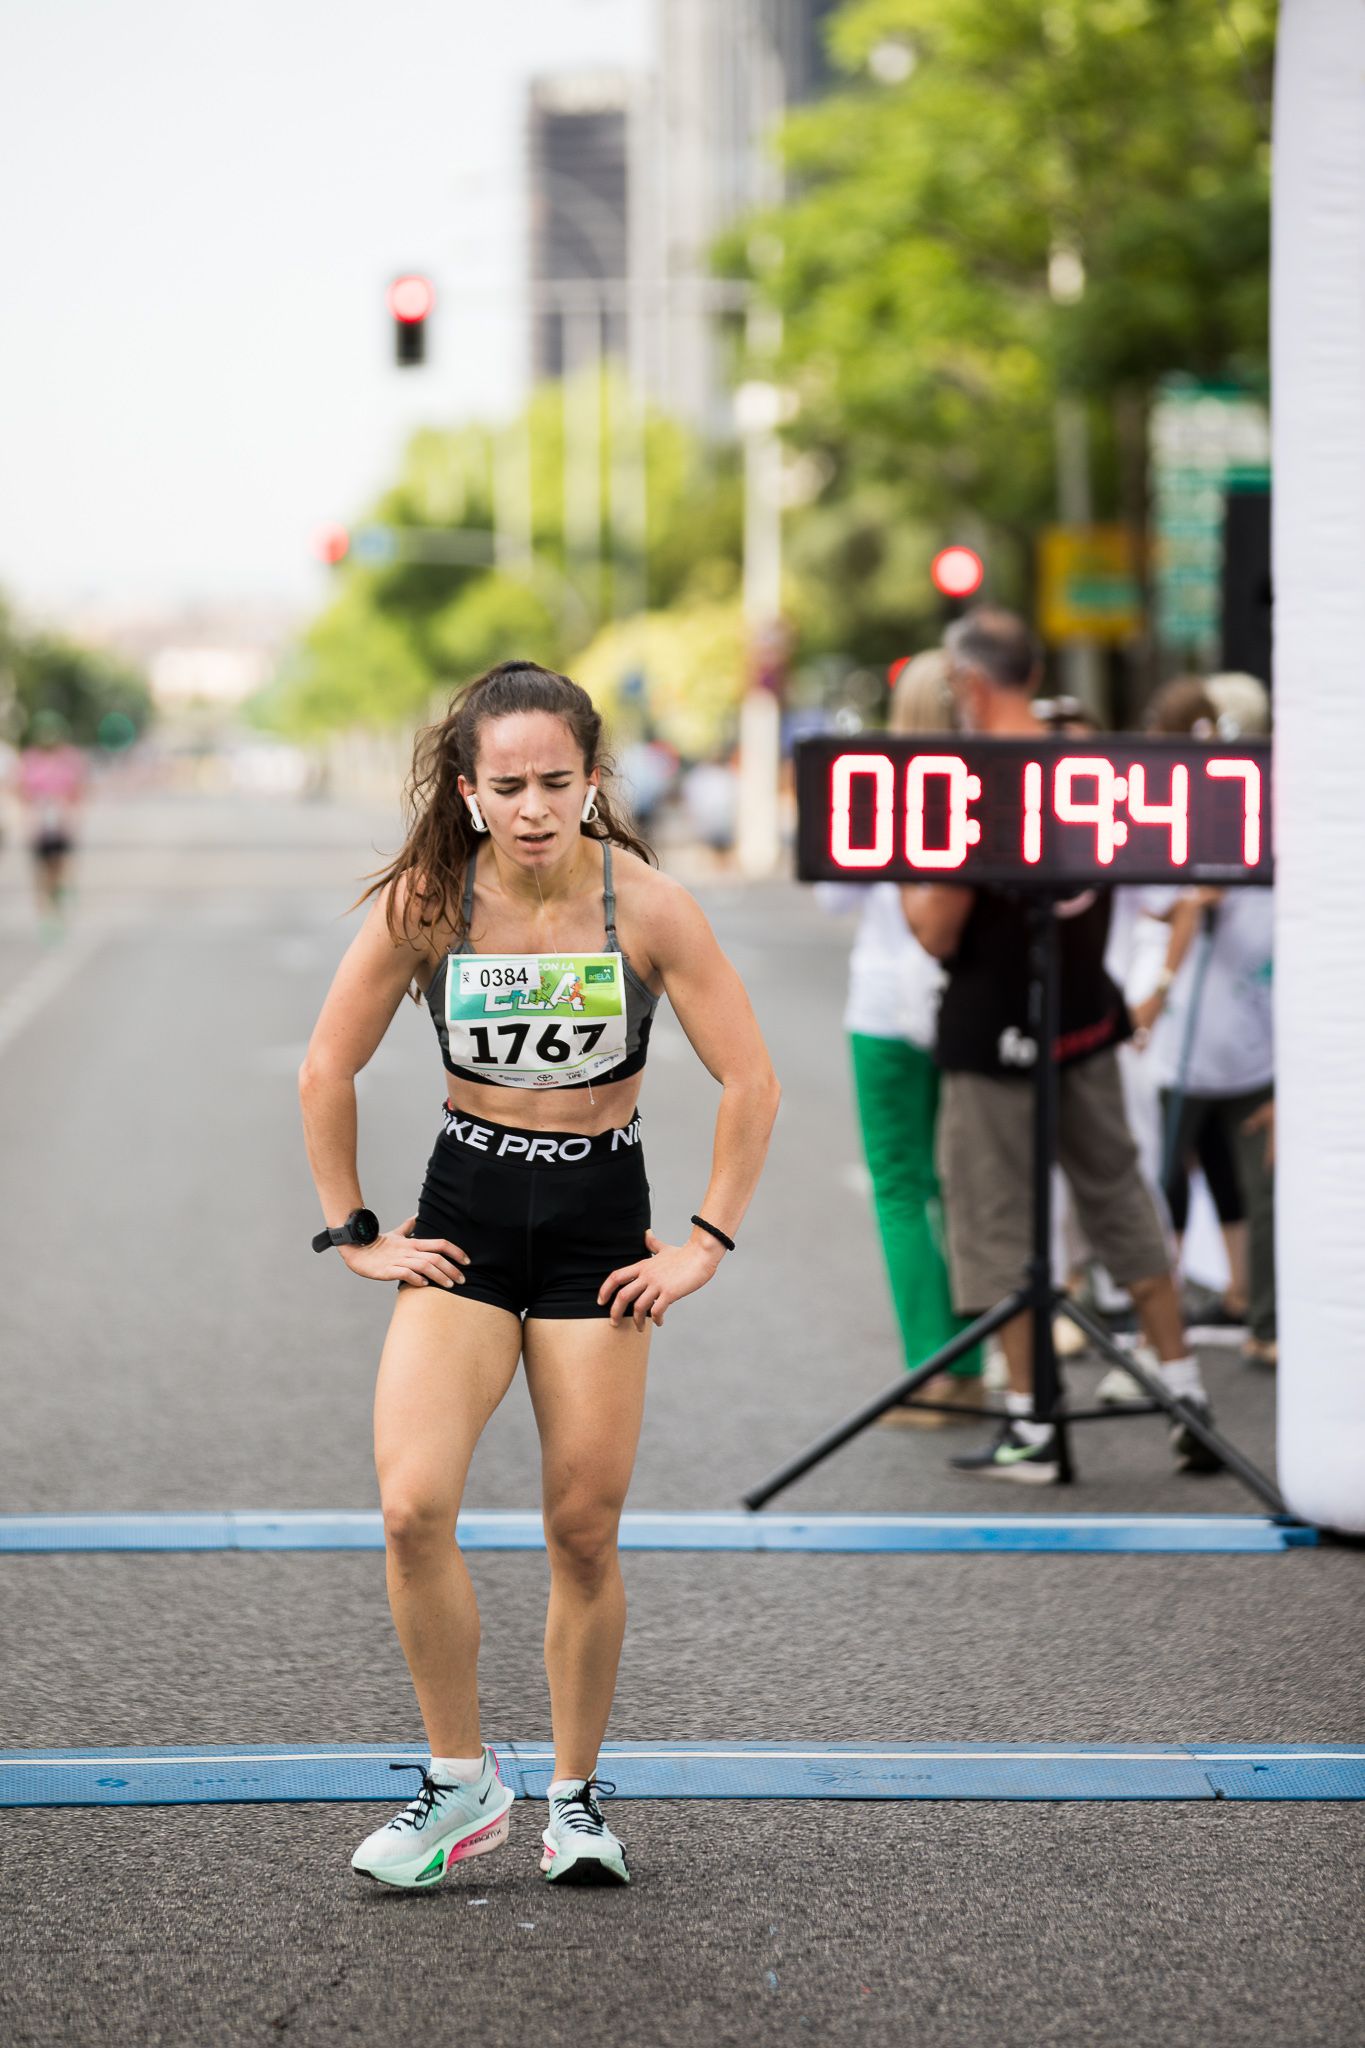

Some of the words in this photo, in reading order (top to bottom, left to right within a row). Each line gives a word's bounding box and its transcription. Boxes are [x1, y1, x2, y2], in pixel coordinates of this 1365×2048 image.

[831, 754, 1261, 868] 00:19:47
[480, 967, 529, 988] 0384
[560, 962, 575, 971] LA
[469, 1023, 607, 1065] 1767
[496, 1133, 591, 1163] PRO
[611, 1118, 642, 1151] NI
